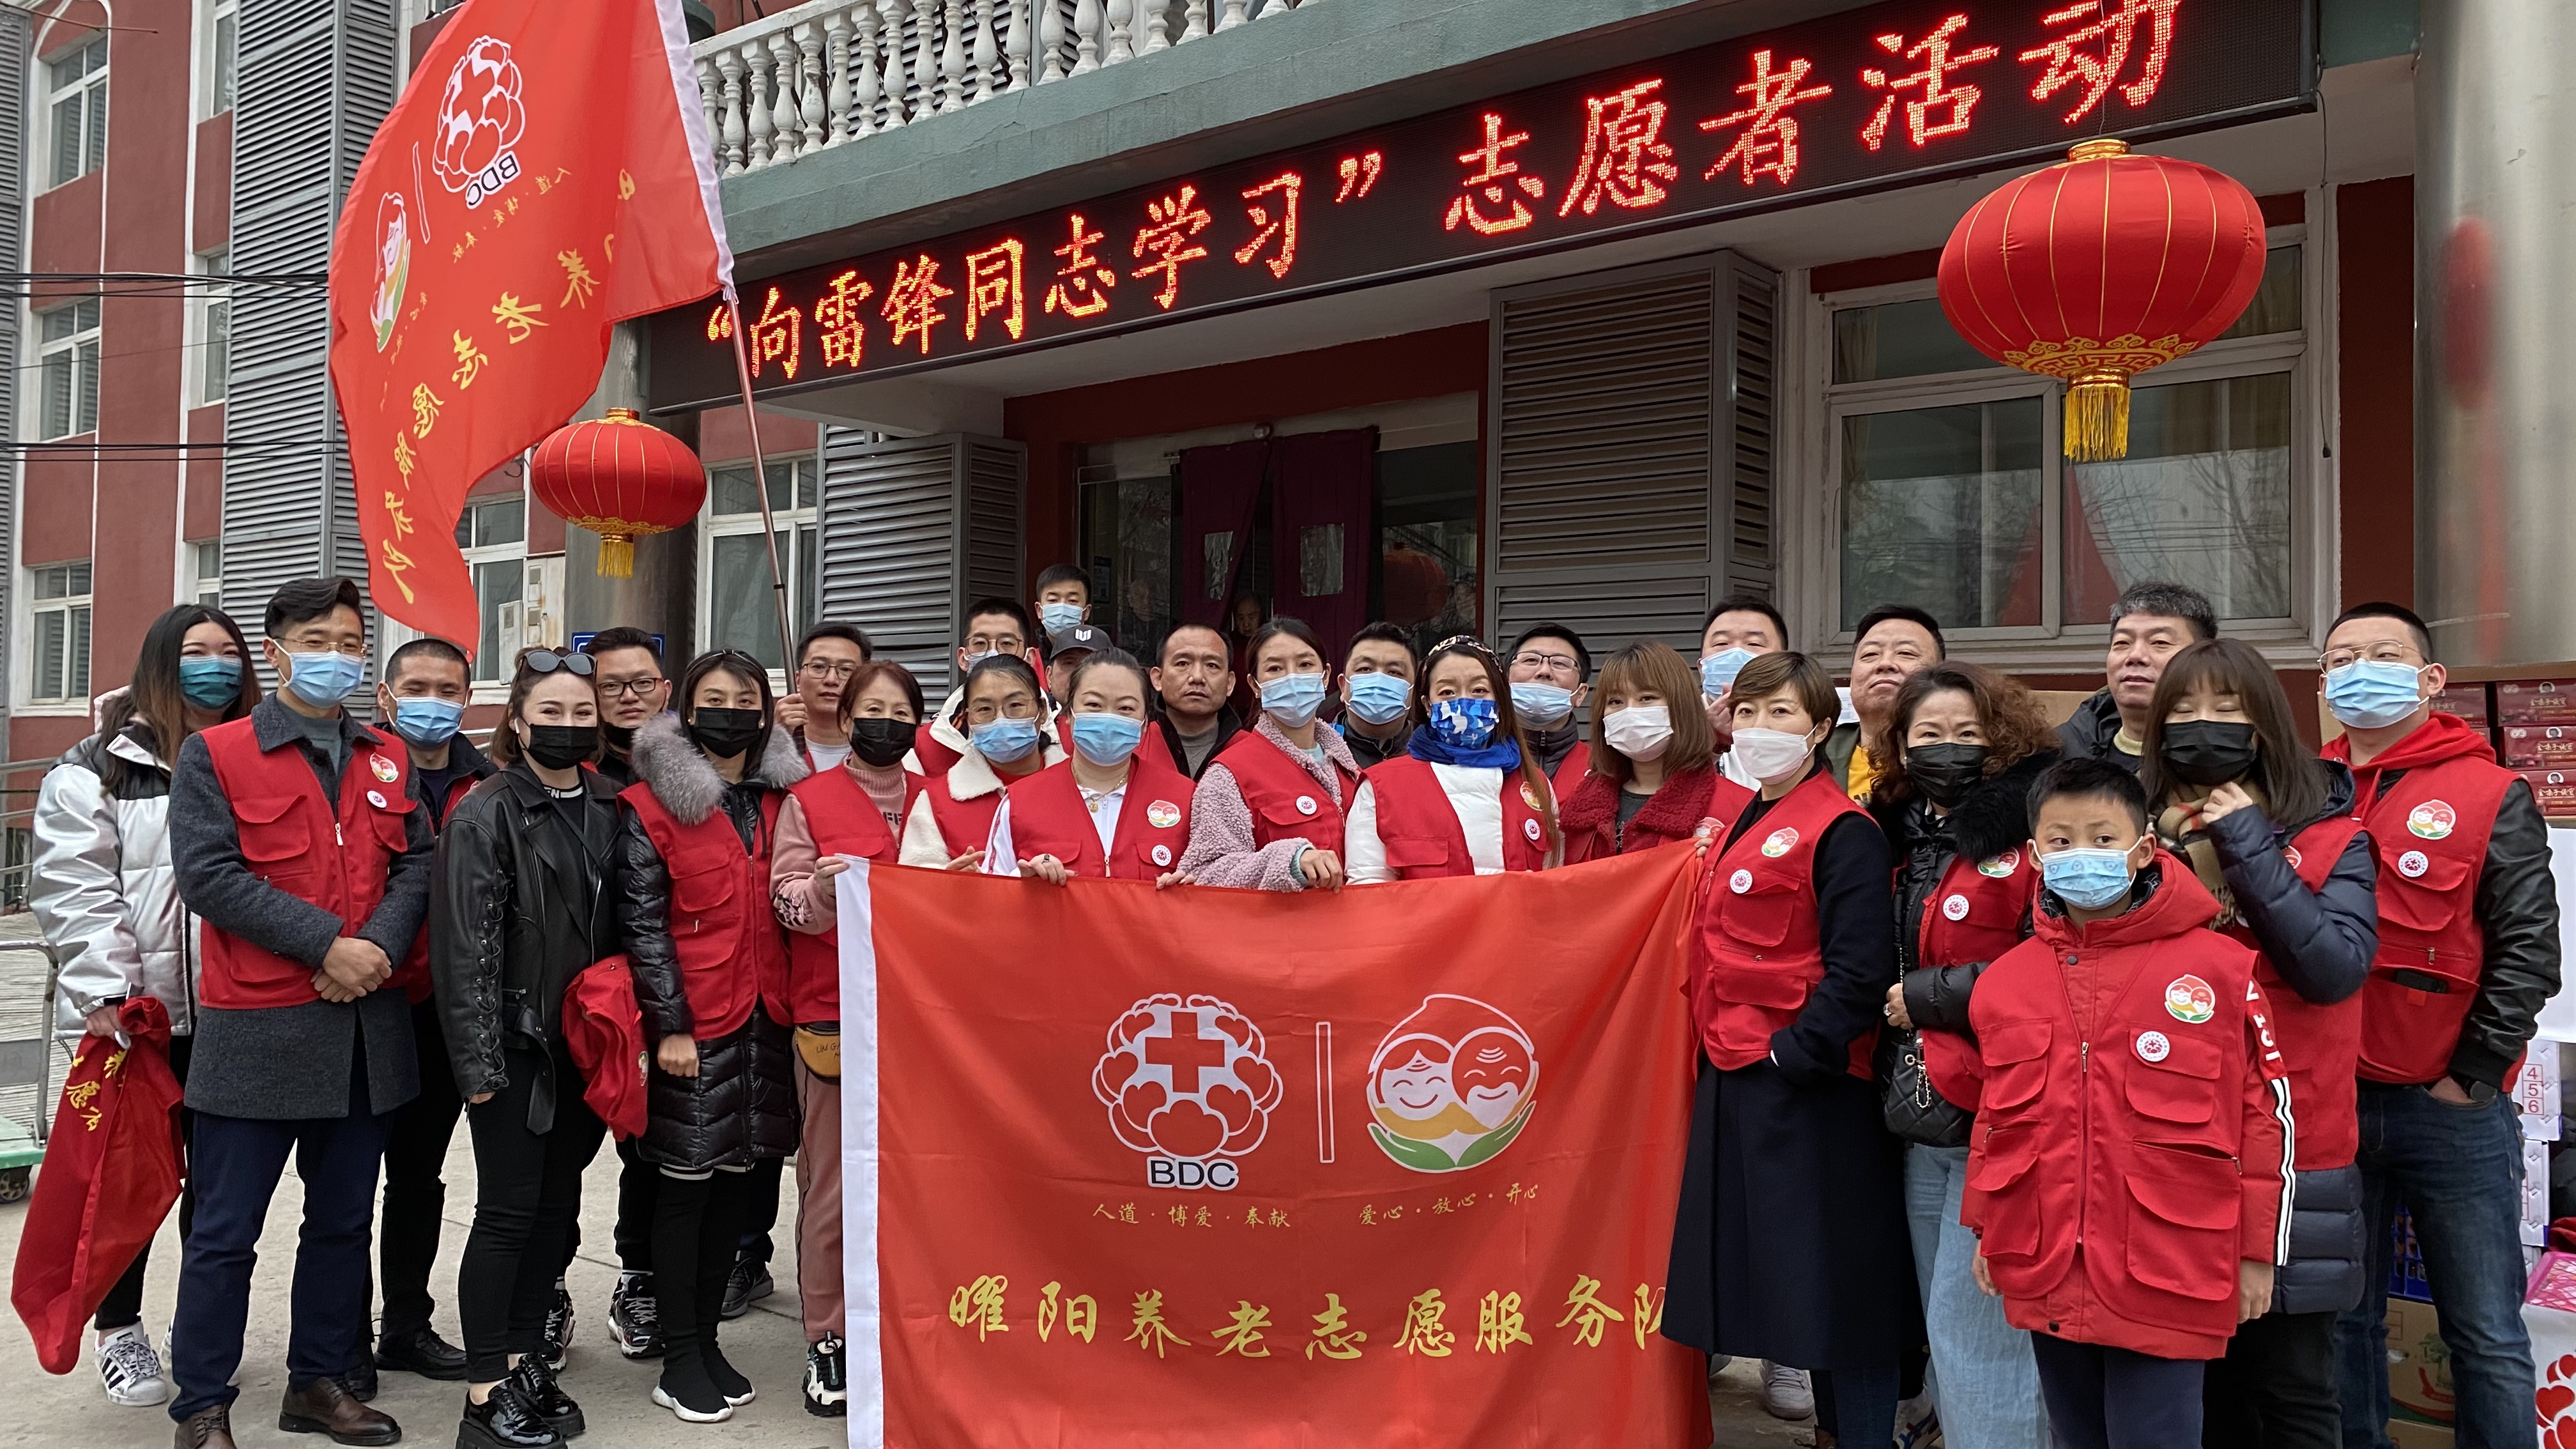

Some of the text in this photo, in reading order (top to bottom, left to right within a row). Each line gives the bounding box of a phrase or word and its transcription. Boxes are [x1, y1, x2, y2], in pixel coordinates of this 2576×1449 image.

[2527, 1067, 2538, 1080] 4
[2527, 1084, 2538, 1096] 5
[2528, 1100, 2539, 1113] 6
[1151, 1160, 1237, 1188] BDC
